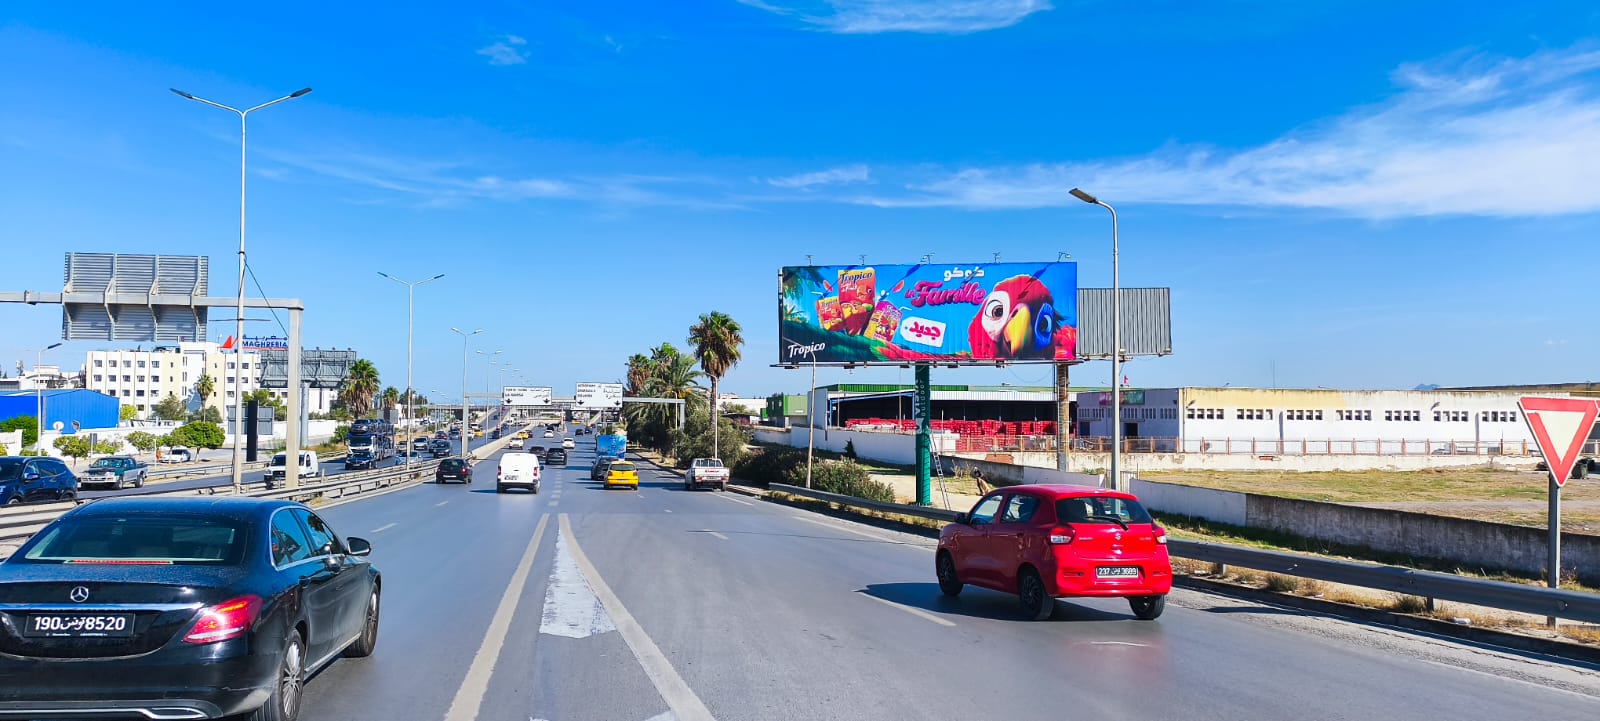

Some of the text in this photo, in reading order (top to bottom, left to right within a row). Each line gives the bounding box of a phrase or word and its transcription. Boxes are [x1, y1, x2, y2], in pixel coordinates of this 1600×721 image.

[943, 266, 985, 282] كوكو
[910, 281, 986, 308] Famille
[909, 321, 941, 341] جديد
[788, 341, 826, 358] Tropico
[35, 616, 61, 631] 190
[85, 616, 126, 631] 8520
